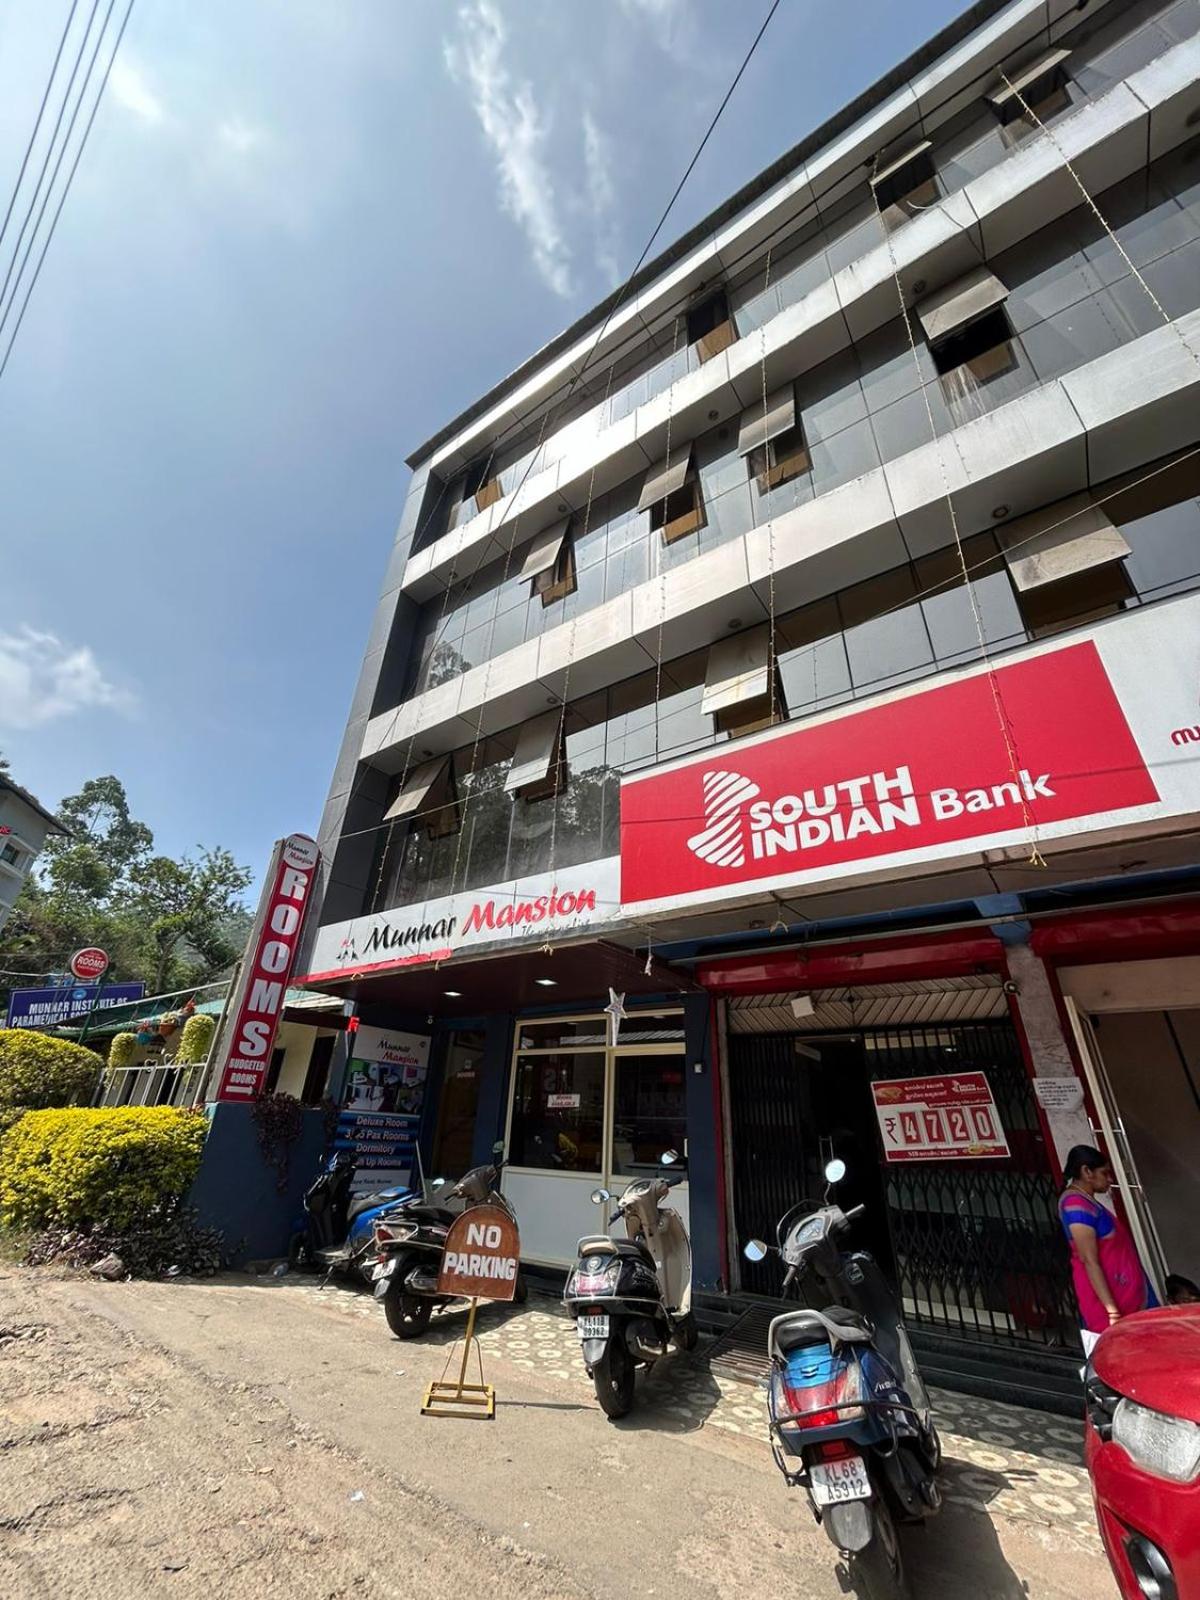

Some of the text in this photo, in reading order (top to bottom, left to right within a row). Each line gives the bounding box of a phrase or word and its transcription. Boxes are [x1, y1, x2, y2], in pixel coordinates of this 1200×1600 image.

[749, 765, 915, 831] SOUTH
[752, 769, 1056, 859] INDIAN Bank
[363, 915, 457, 954] Munnar
[462, 886, 597, 936] Mansion
[77, 956, 105, 969] ROOMS
[238, 867, 309, 1056] ROOMS
[356, 1116, 408, 1127] Deluxe Room
[905, 1111, 992, 1140] 4720
[355, 1143, 396, 1155] Dormitory
[366, 1130, 381, 1140] Pax
[382, 1130, 410, 1141] Rooms
[466, 1223, 502, 1249] NO
[442, 1251, 516, 1280] PARKING
[828, 1478, 867, 1501] A5912
